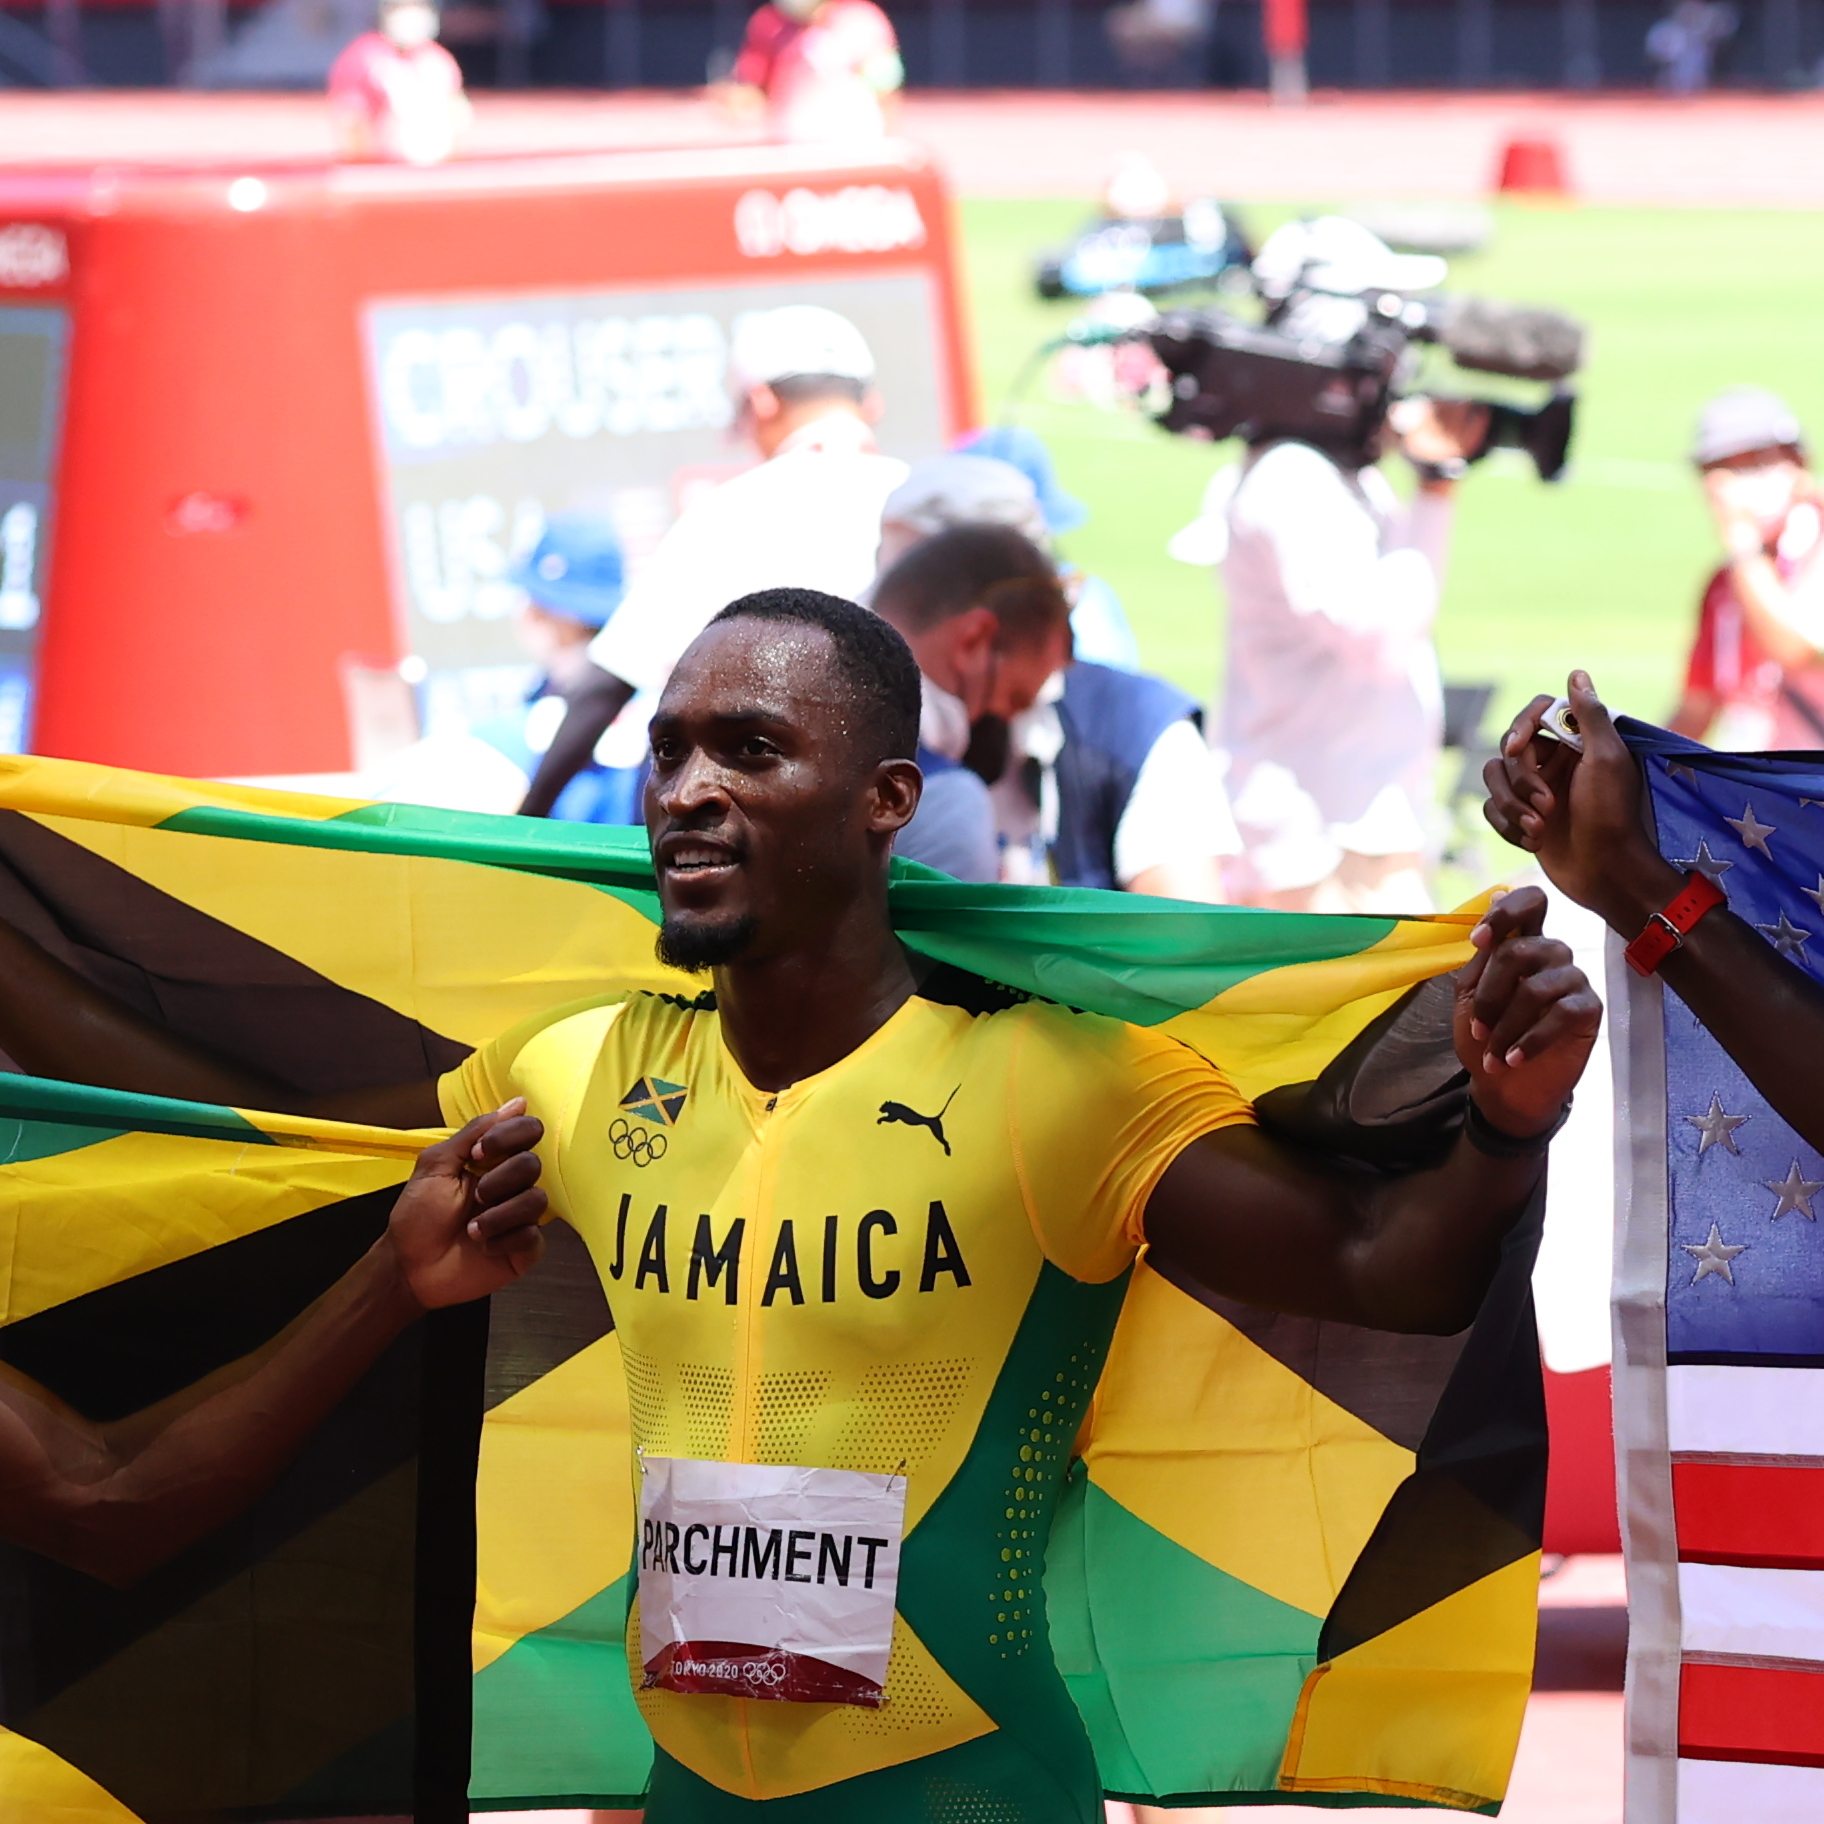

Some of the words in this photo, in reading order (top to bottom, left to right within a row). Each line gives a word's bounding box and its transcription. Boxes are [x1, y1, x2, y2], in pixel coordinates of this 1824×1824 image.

[380, 312, 738, 450] CROUSER
[608, 1192, 973, 1308] JAMAICA
[641, 1517, 889, 1590] PARCHMENT
[707, 1662, 739, 1679] 2020
